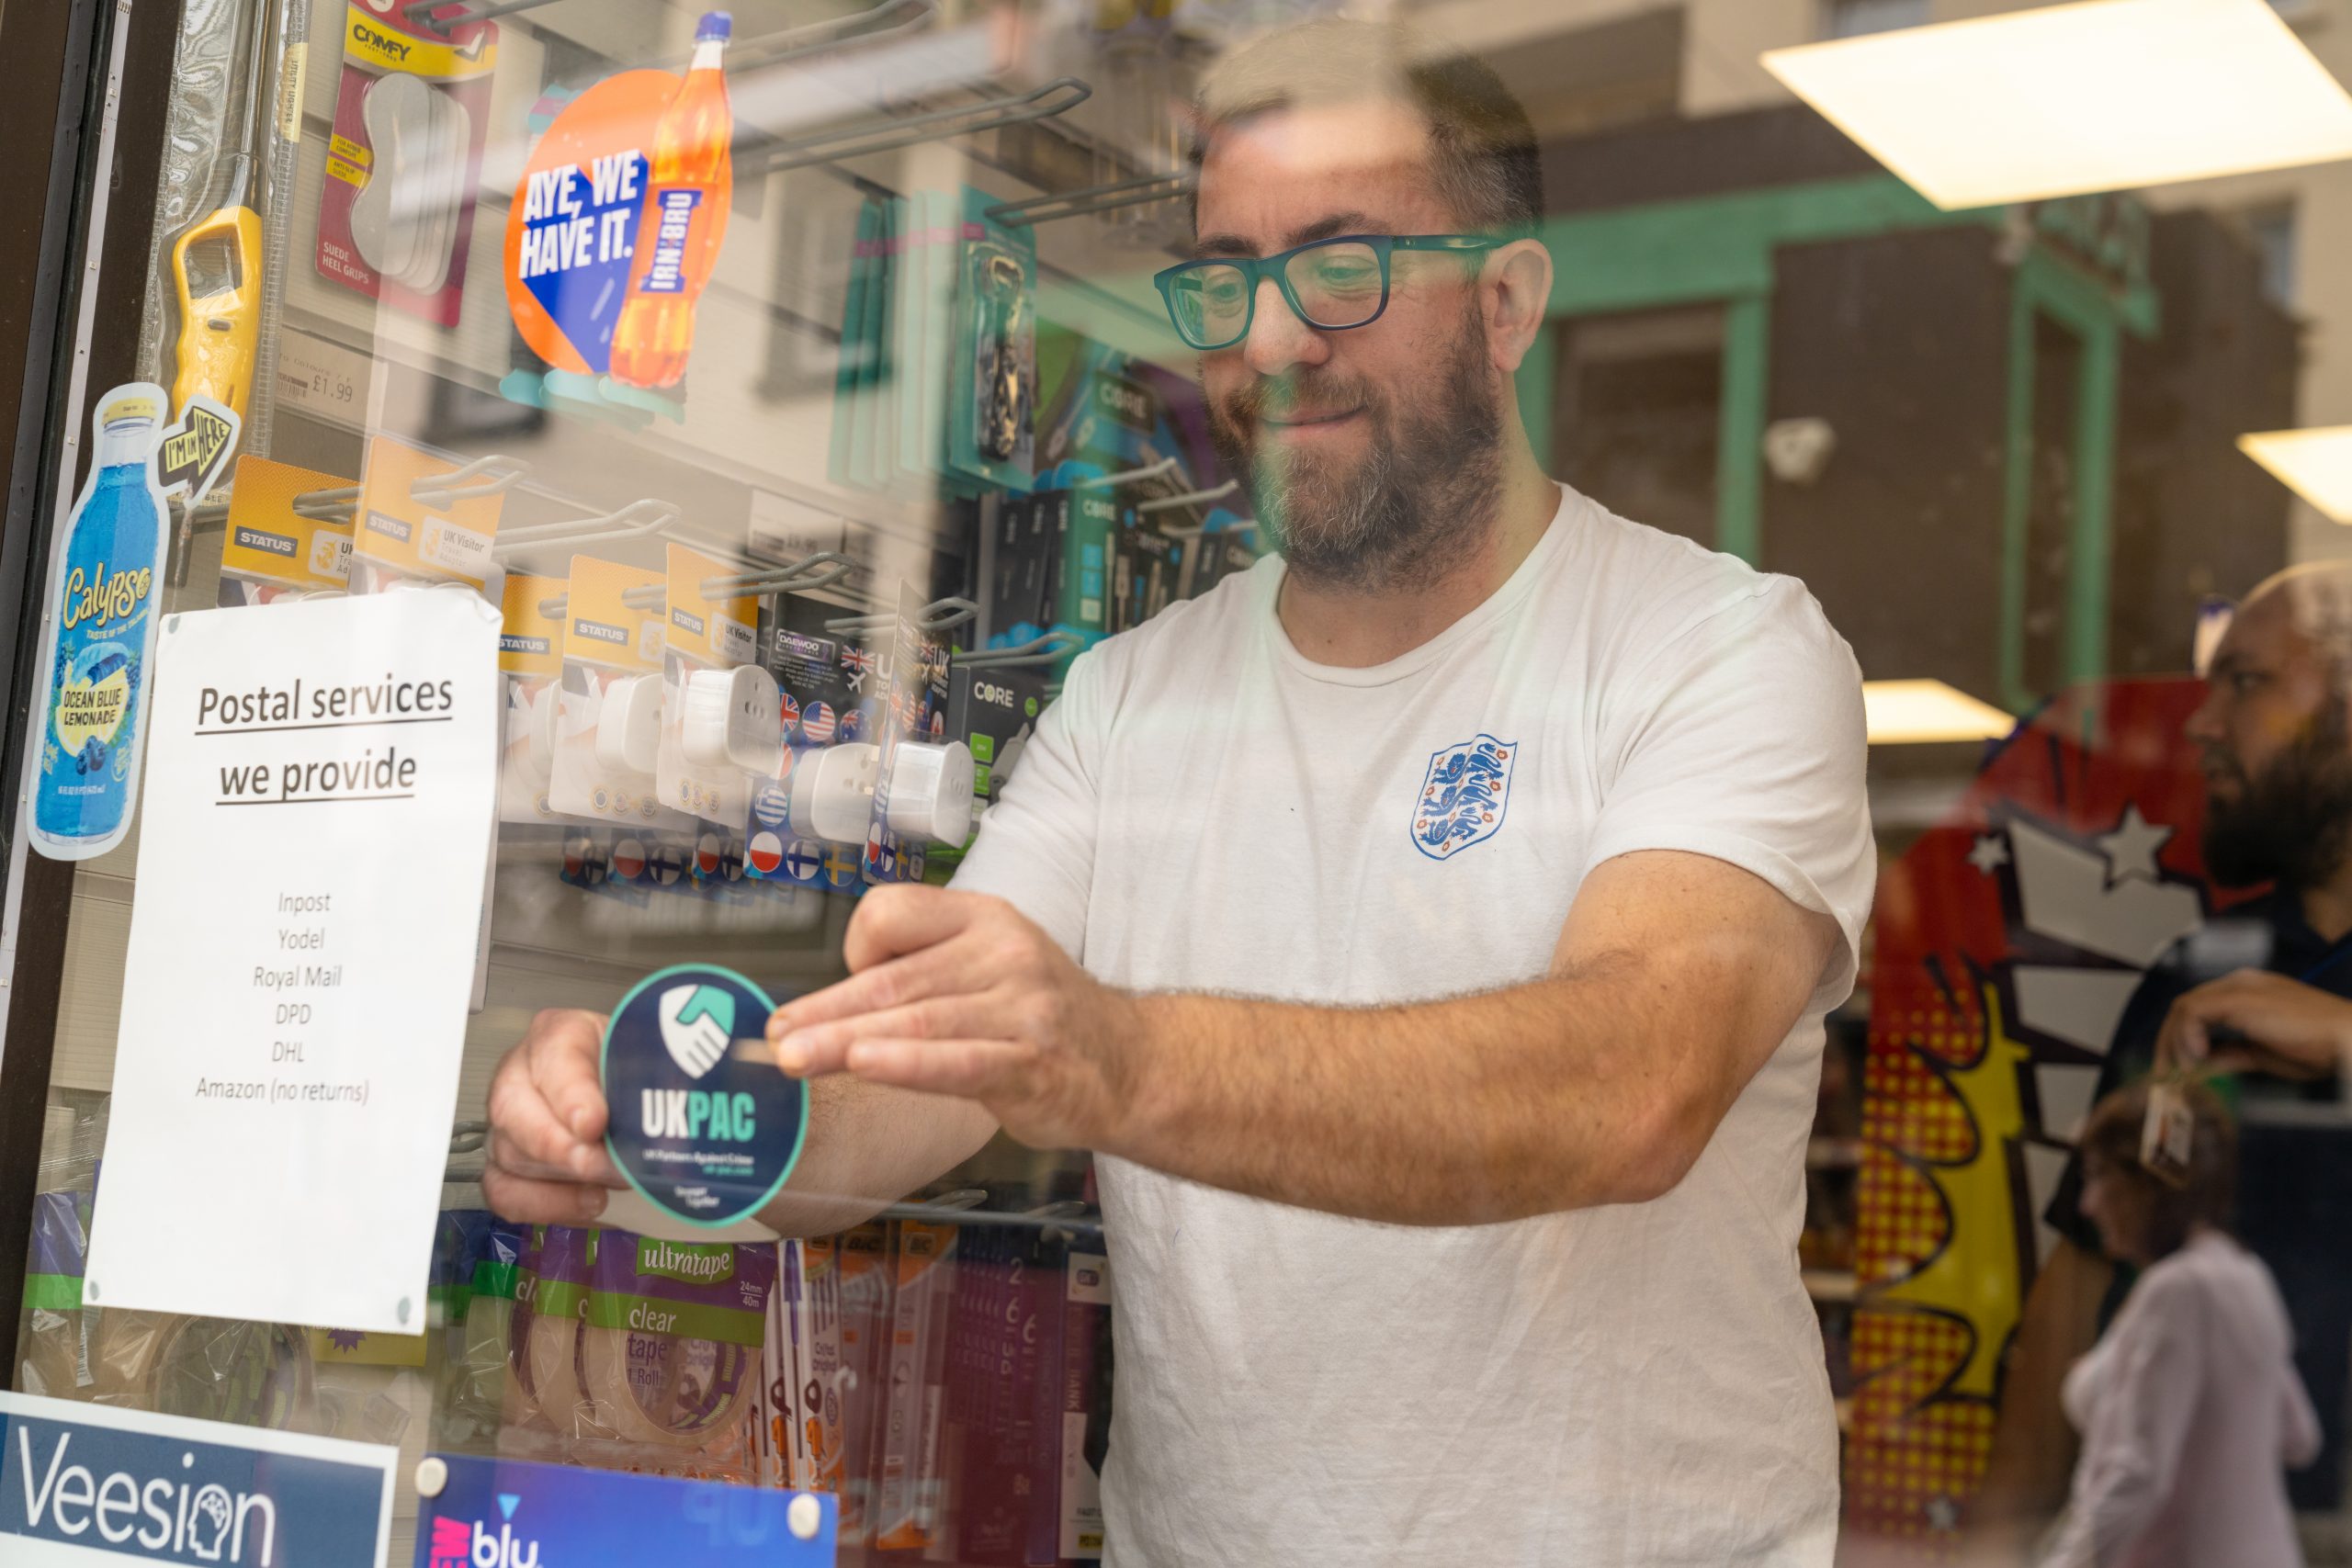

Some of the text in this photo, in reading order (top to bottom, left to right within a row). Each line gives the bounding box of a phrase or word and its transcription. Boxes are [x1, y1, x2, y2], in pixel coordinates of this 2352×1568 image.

[353, 24, 412, 62] COMFY
[286, 60, 299, 123] UTILITY LIGHTER
[523, 149, 641, 223] AYE, WE
[323, 242, 349, 263] SUEDE
[519, 209, 633, 279] HAVE IT.
[322, 255, 369, 285] HEEL GRIPS
[312, 375, 354, 403] £1.99
[168, 441, 187, 468] I'M
[197, 413, 226, 466] HERE
[369, 515, 409, 537] STATUS
[241, 532, 292, 552] STATUS
[444, 529, 485, 553] UK Visitor
[339, 556, 353, 566] Tra
[63, 562, 151, 629] Calypso
[579, 623, 626, 641] STATUS
[674, 612, 703, 632] STATUS
[499, 637, 548, 651] STATUS
[734, 628, 752, 644] Visitor
[779, 634, 820, 651] DAEWOO
[63, 688, 122, 708] OCEAN BLUE
[198, 672, 453, 726] Postal services
[974, 682, 1014, 708] CORE
[63, 709, 117, 726] LEMONADE
[220, 747, 416, 801] we provide
[278, 891, 331, 918] Inpost
[278, 928, 324, 950] Yodel
[254, 965, 342, 991] Royal Mail
[276, 1004, 311, 1025] DPD
[272, 1042, 305, 1063] DHL
[197, 1077, 369, 1106] Amazon (no returns)
[641, 1089, 756, 1142] UKPAC
[644, 1242, 730, 1280] ultratape
[740, 1280, 763, 1295] 24mm
[742, 1295, 761, 1308] 40m
[629, 1303, 677, 1332] clear
[628, 1333, 668, 1367] tape
[638, 1369, 660, 1385] Roll
